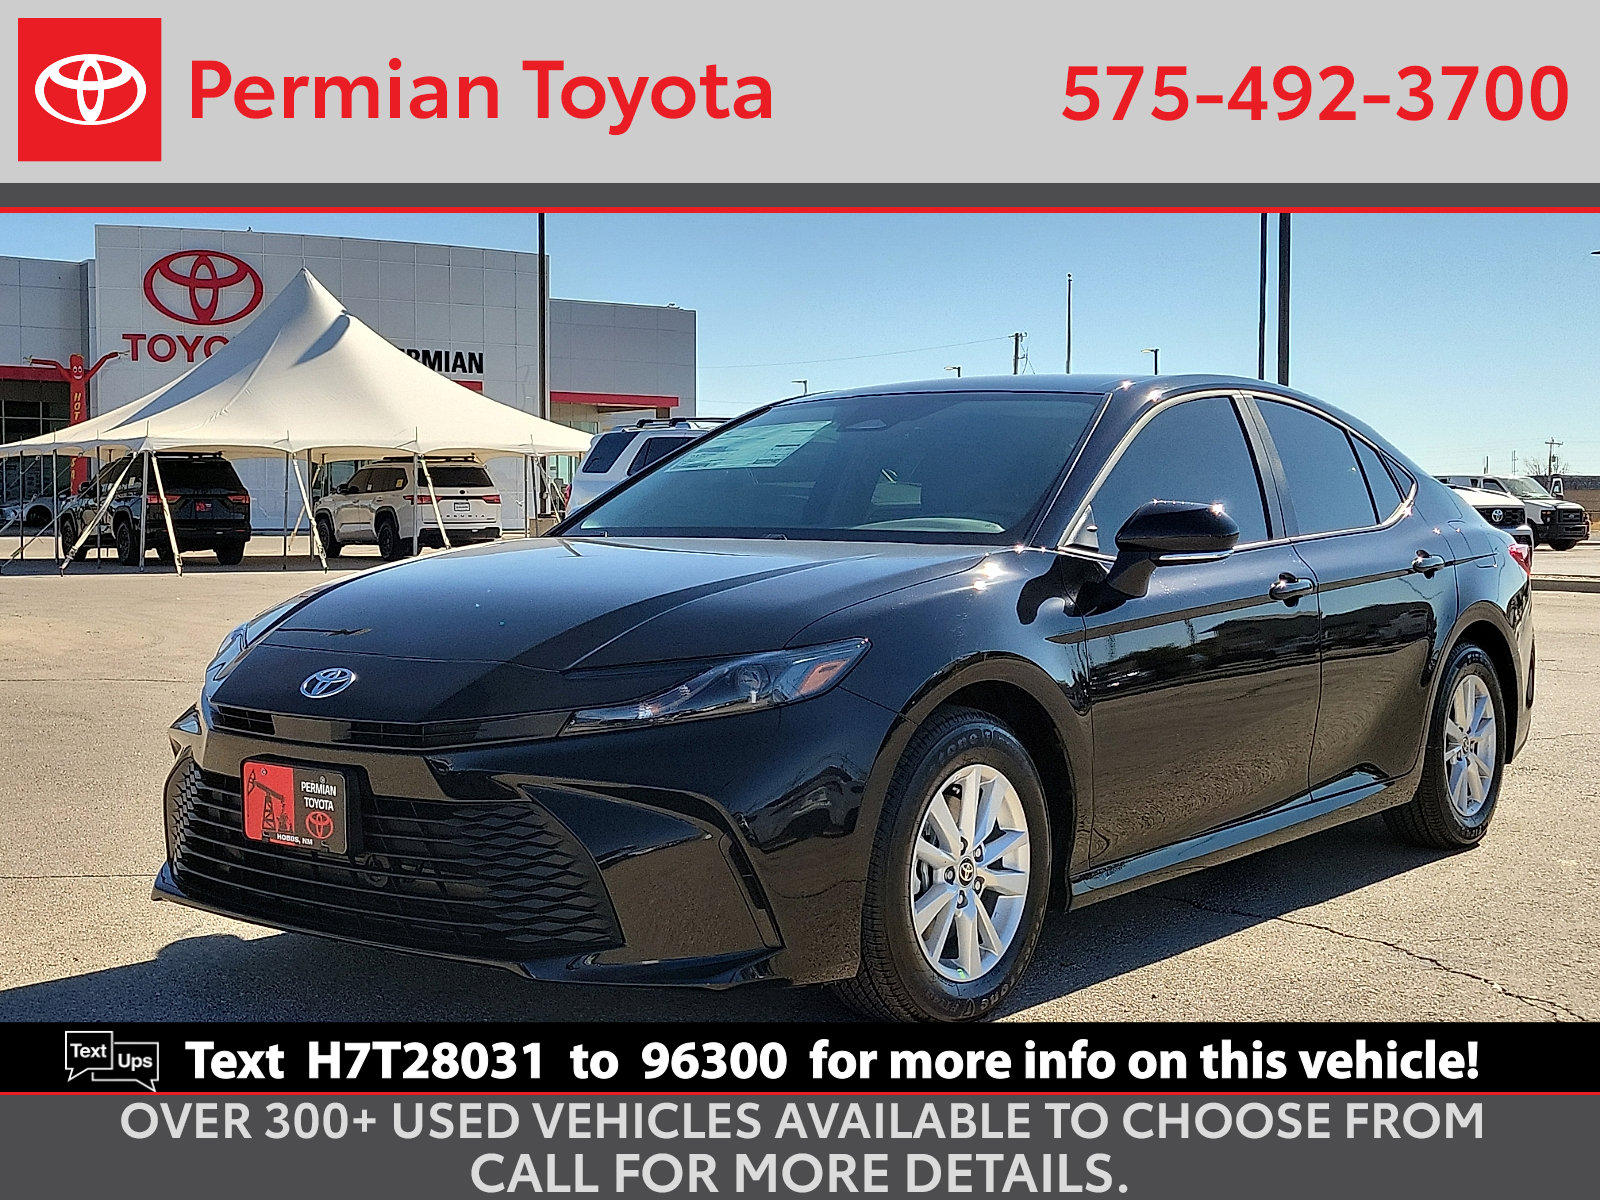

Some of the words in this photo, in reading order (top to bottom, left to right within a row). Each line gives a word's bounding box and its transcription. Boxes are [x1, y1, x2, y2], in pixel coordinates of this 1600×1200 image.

[399, 348, 484, 374] MIAN
[73, 392, 82, 421] HOT
[301, 781, 337, 797] PERMIAN
[304, 796, 335, 812] TOYOTA
[302, 837, 313, 846] NM
